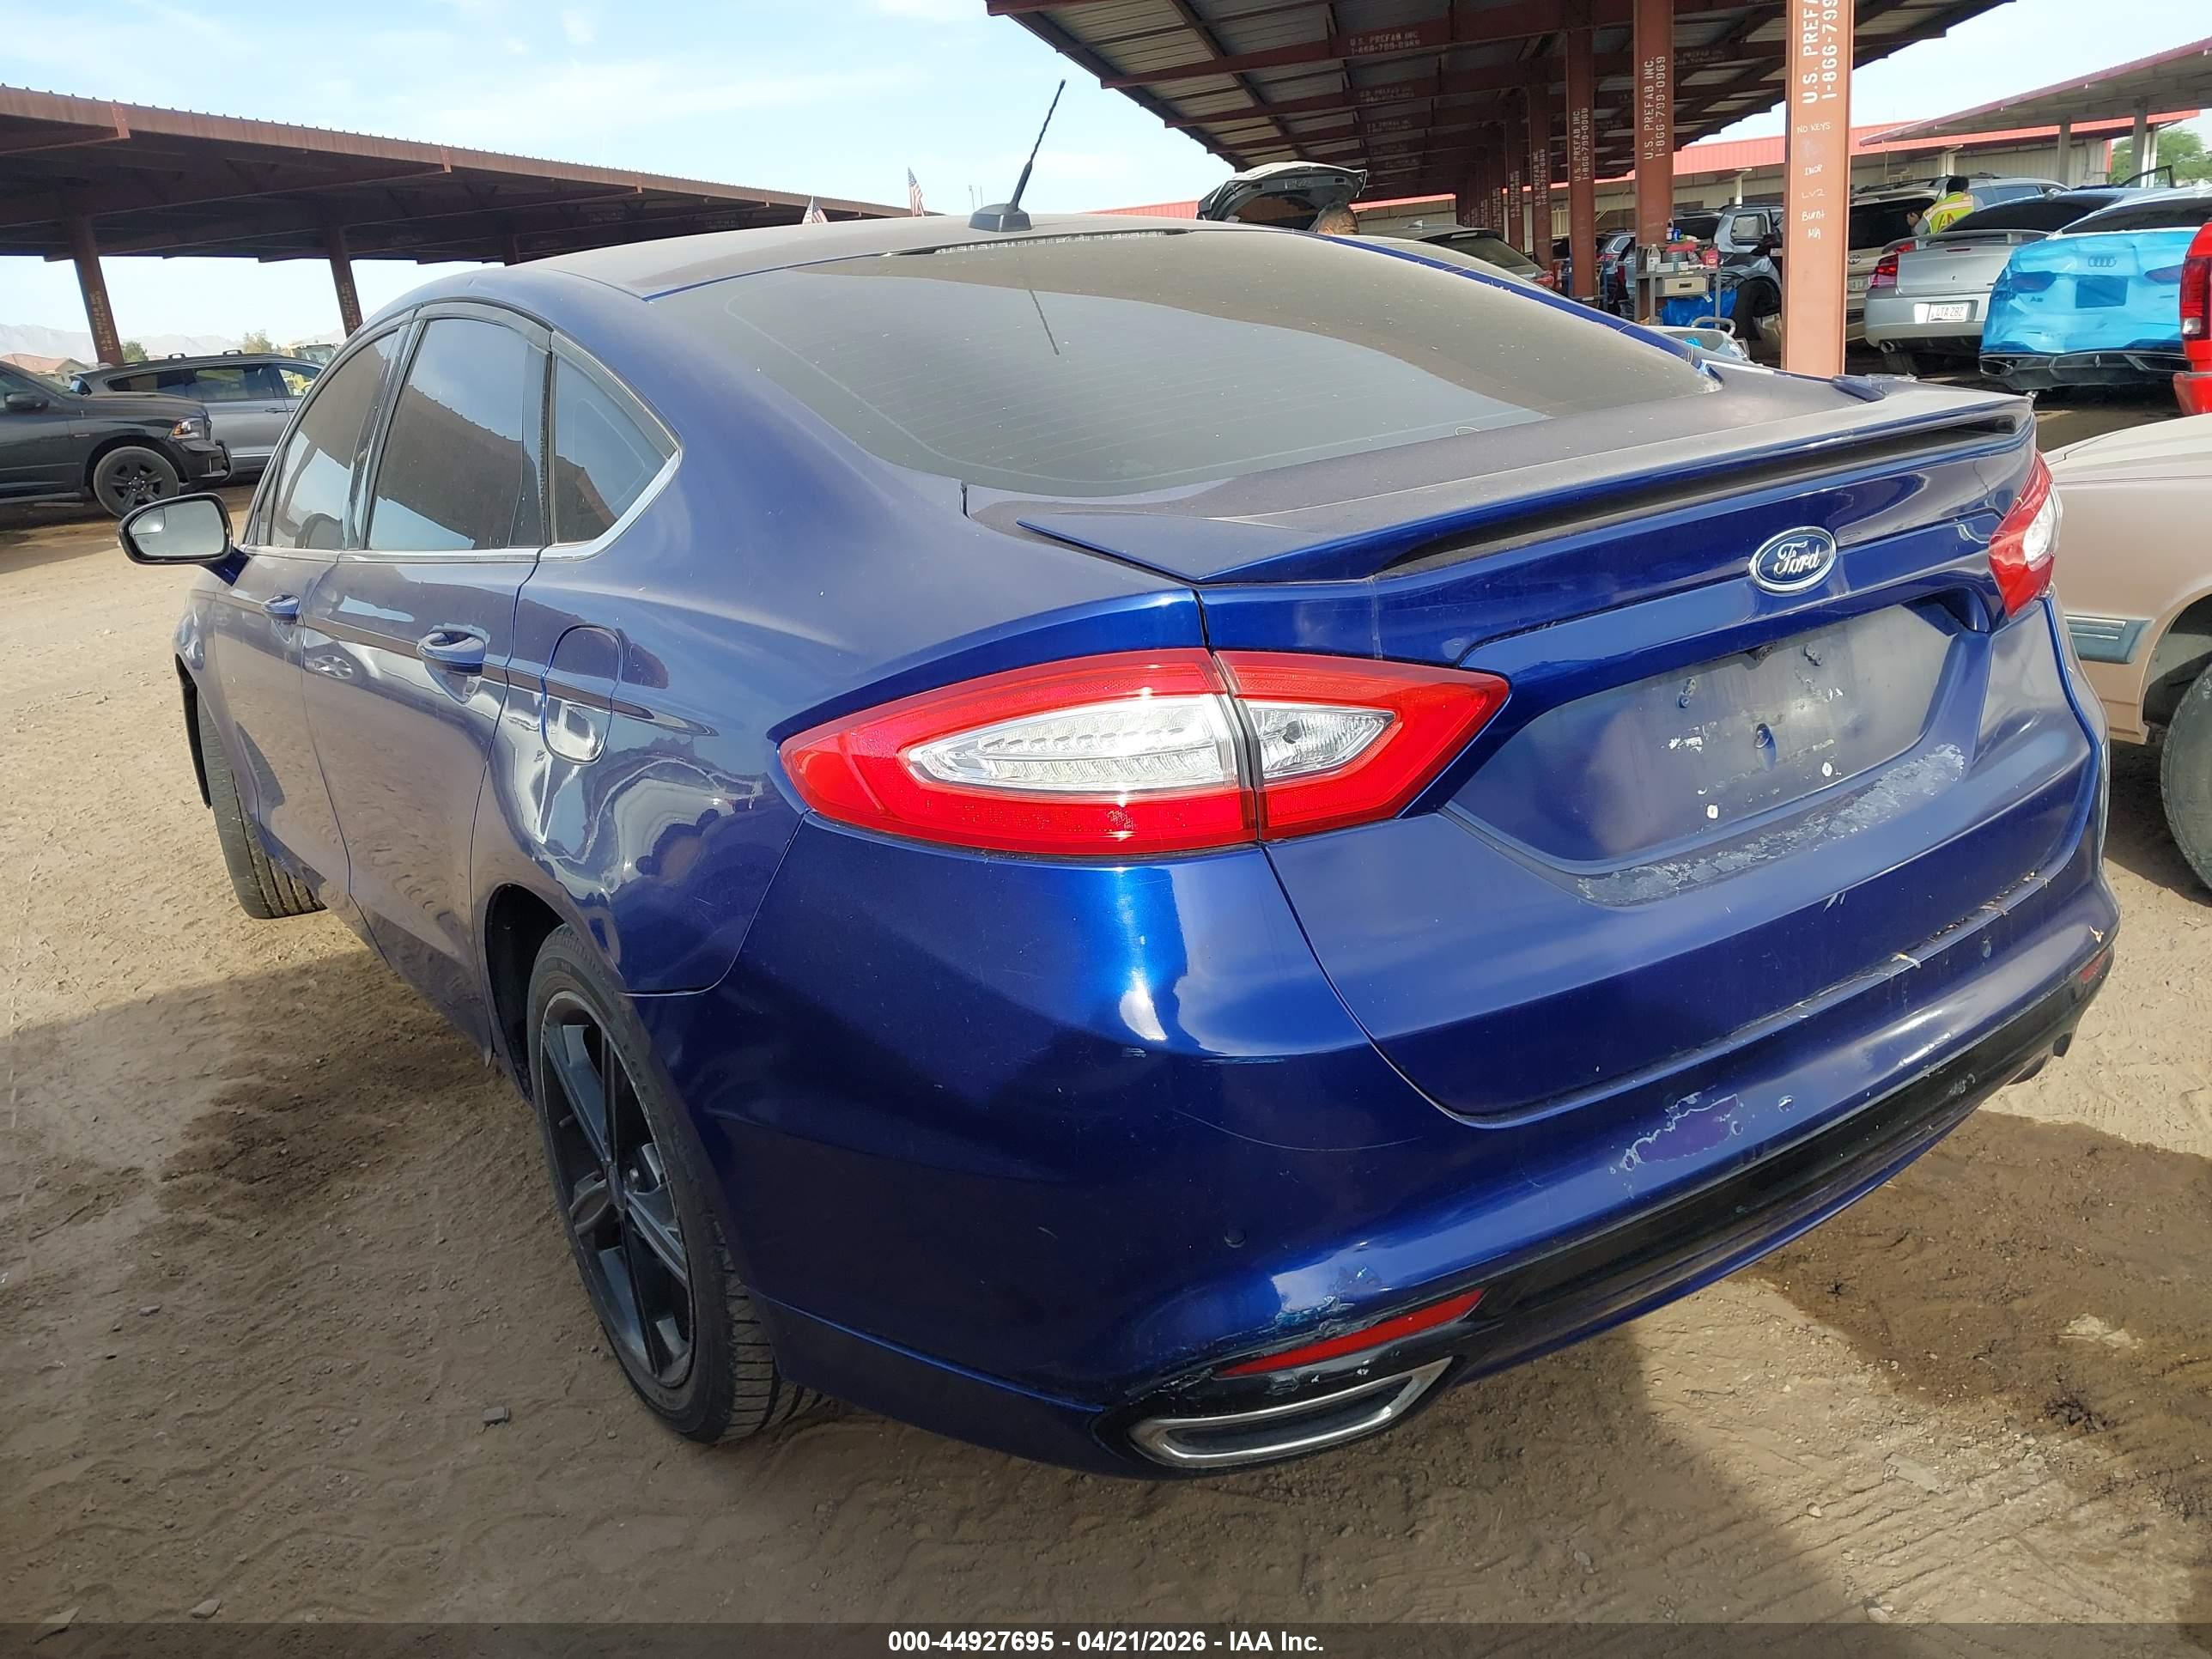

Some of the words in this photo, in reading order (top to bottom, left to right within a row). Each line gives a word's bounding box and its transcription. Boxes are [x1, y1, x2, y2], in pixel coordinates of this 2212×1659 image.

[1644, 56, 1654, 79] INC.
[1802, 67, 1819, 104] U.S.
[1644, 85, 1654, 131] PREFAB
[1655, 56, 1666, 157] 1-866-799-0969
[1644, 137, 1654, 160] U.S.
[1773, 539, 1821, 578] Ford
